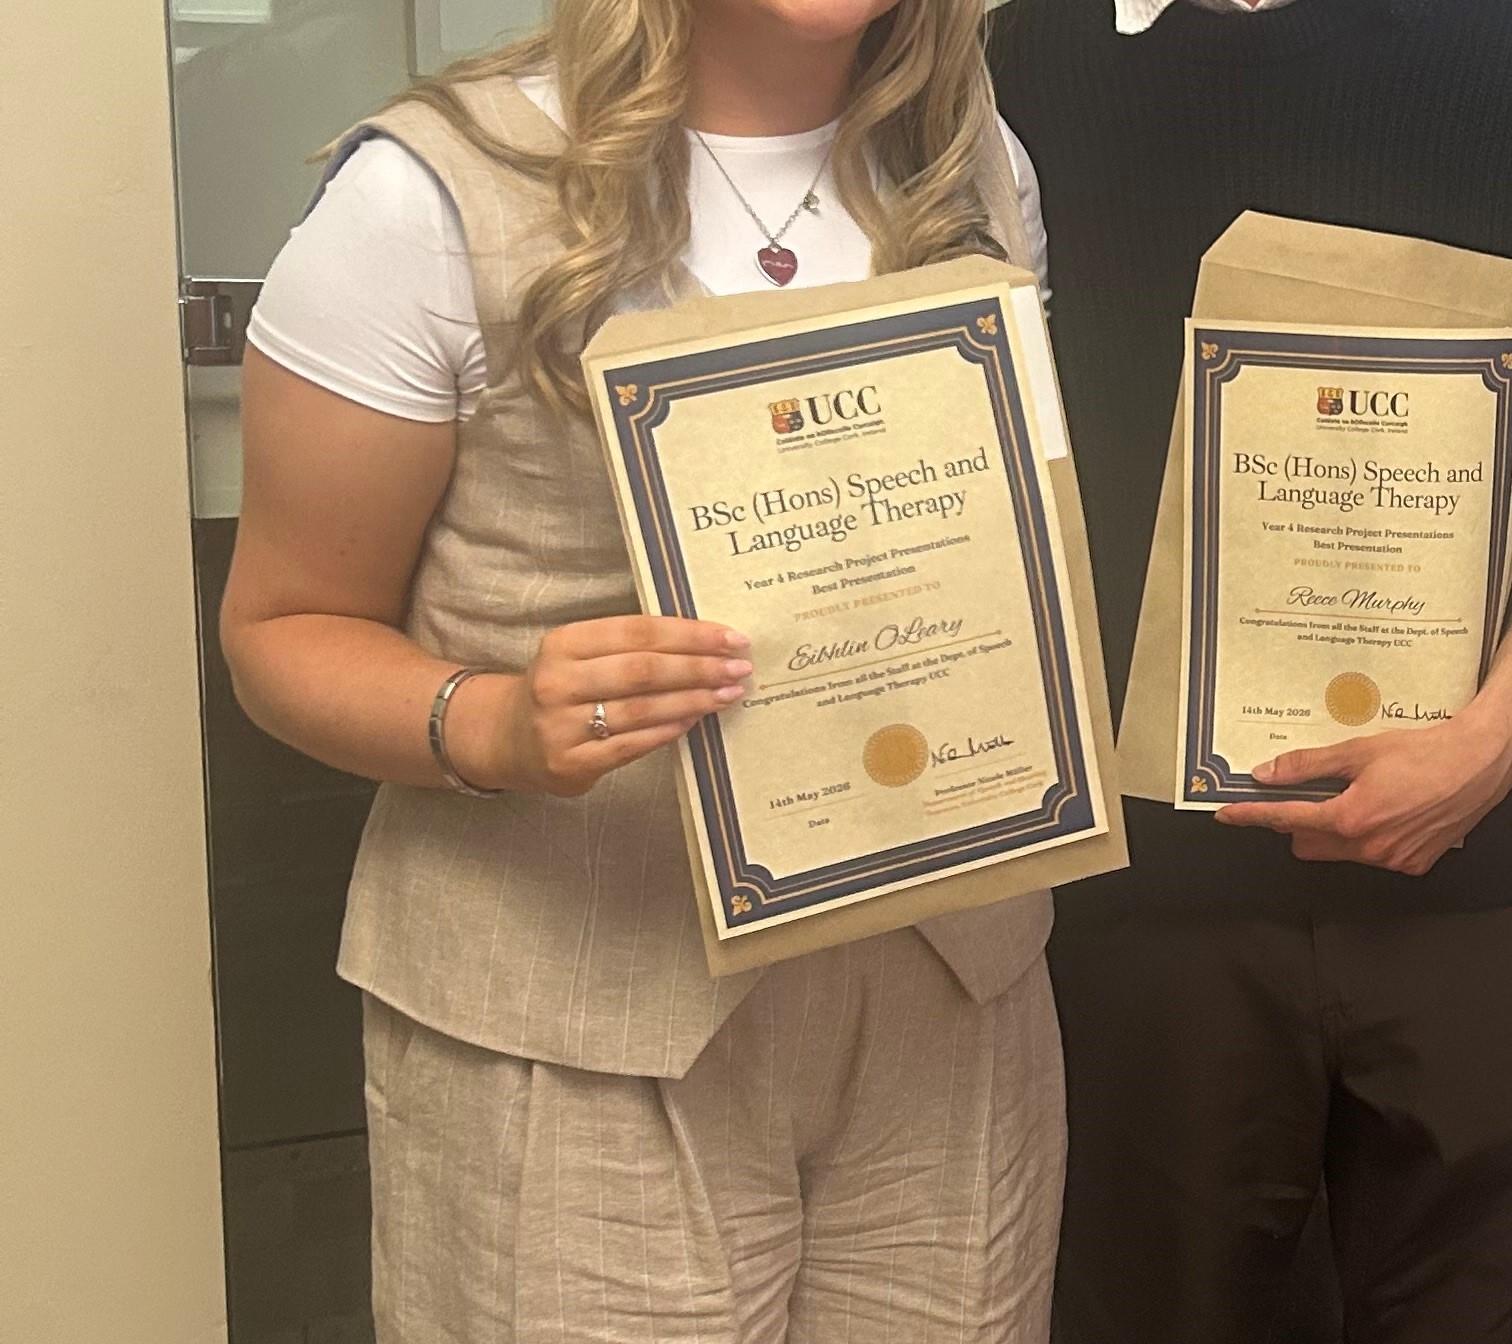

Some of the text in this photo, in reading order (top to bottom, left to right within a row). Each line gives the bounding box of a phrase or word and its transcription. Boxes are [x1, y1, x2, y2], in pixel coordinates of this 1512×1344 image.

[805, 385, 881, 425] UCC
[1349, 389, 1408, 417] UCC
[687, 445, 989, 531] BSc (Hons) Speech and
[1232, 452, 1483, 488] BSc (Hons) Speech and
[1257, 480, 1460, 515] Language Therapy
[726, 489, 966, 556] Language Therapy
[1313, 539, 1402, 553] Best Presentation
